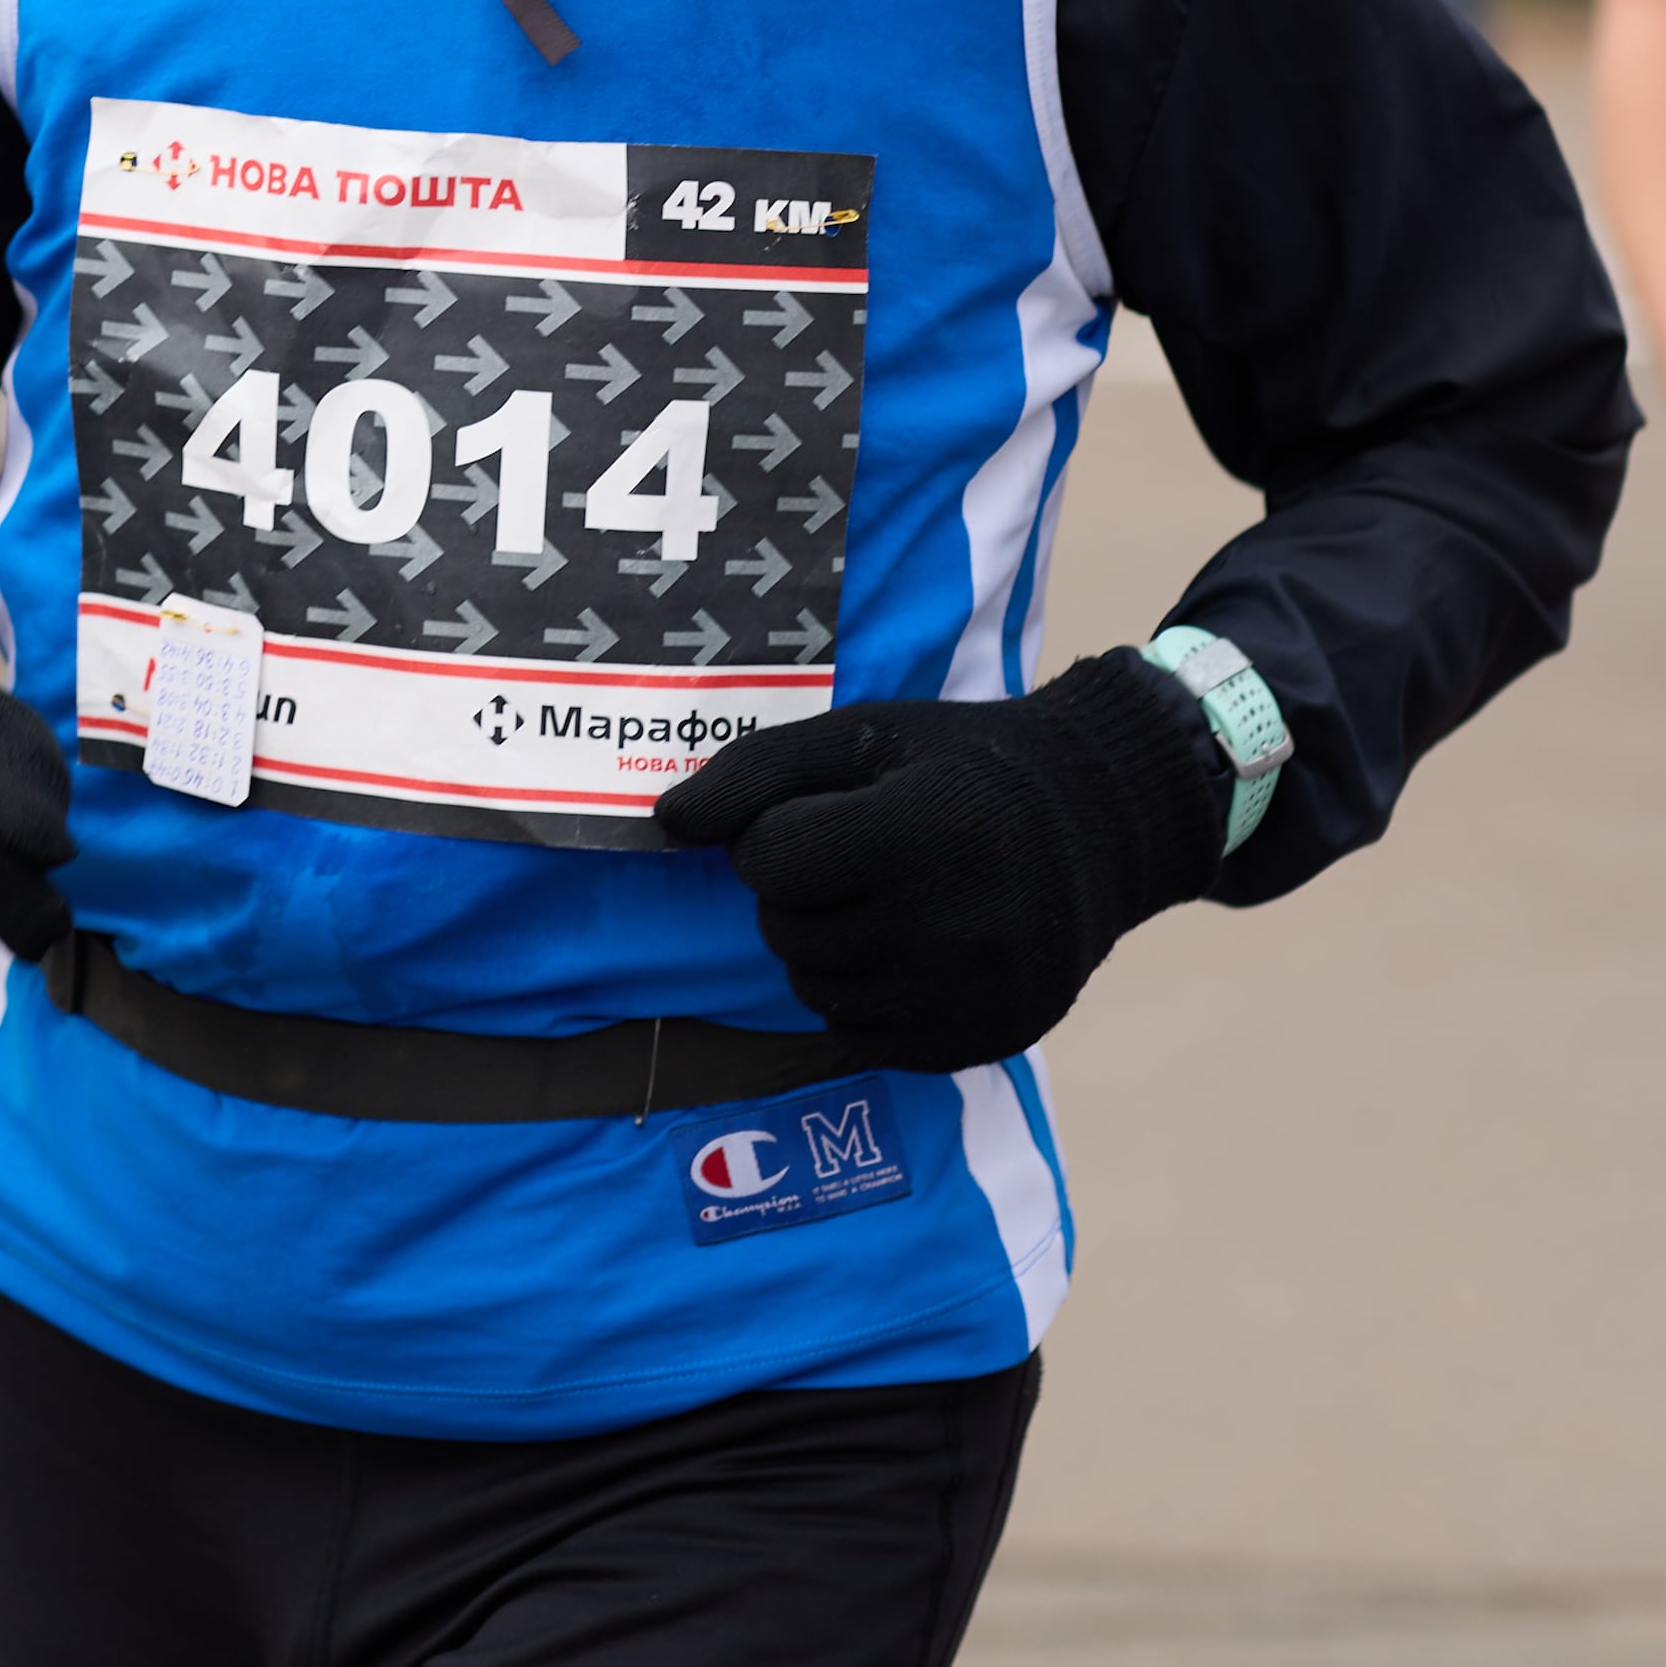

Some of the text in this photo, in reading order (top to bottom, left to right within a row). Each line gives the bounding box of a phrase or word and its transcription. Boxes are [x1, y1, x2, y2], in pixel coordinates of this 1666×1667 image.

[210, 153, 524, 211] НОВА ПОШТА
[661, 179, 736, 232] 42
[181, 370, 719, 562] 4014
[539, 704, 757, 751] Марафон
[618, 756, 678, 773] НОВА
[801, 1100, 882, 1179] M
[700, 1195, 800, 1222] Champion
